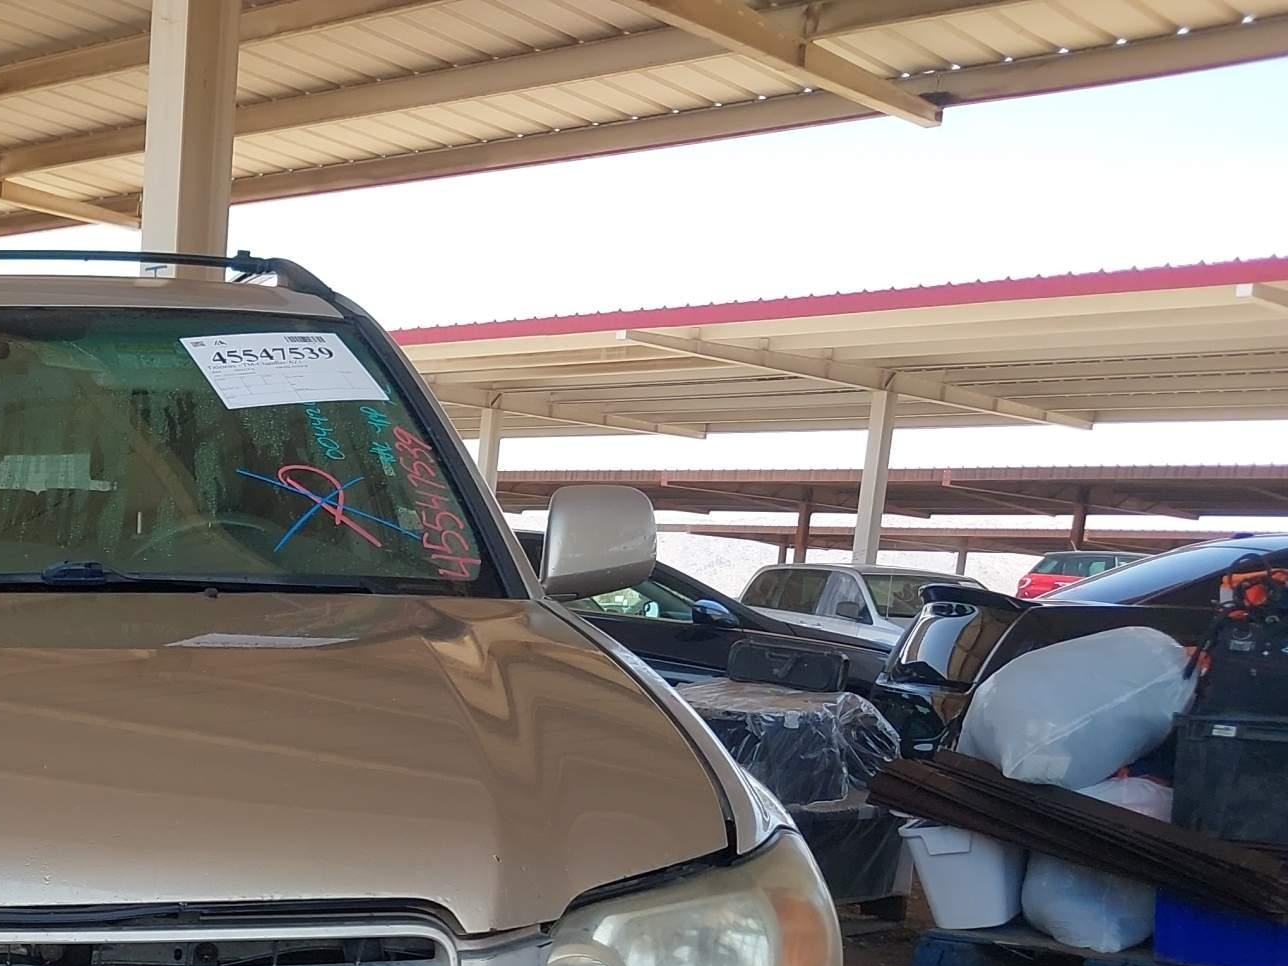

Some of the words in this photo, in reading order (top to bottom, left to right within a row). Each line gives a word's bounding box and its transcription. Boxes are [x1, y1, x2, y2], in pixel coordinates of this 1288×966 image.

[212, 347, 334, 365] 45547539
[307, 401, 346, 462] 00442
[393, 426, 481, 582] 45547539
